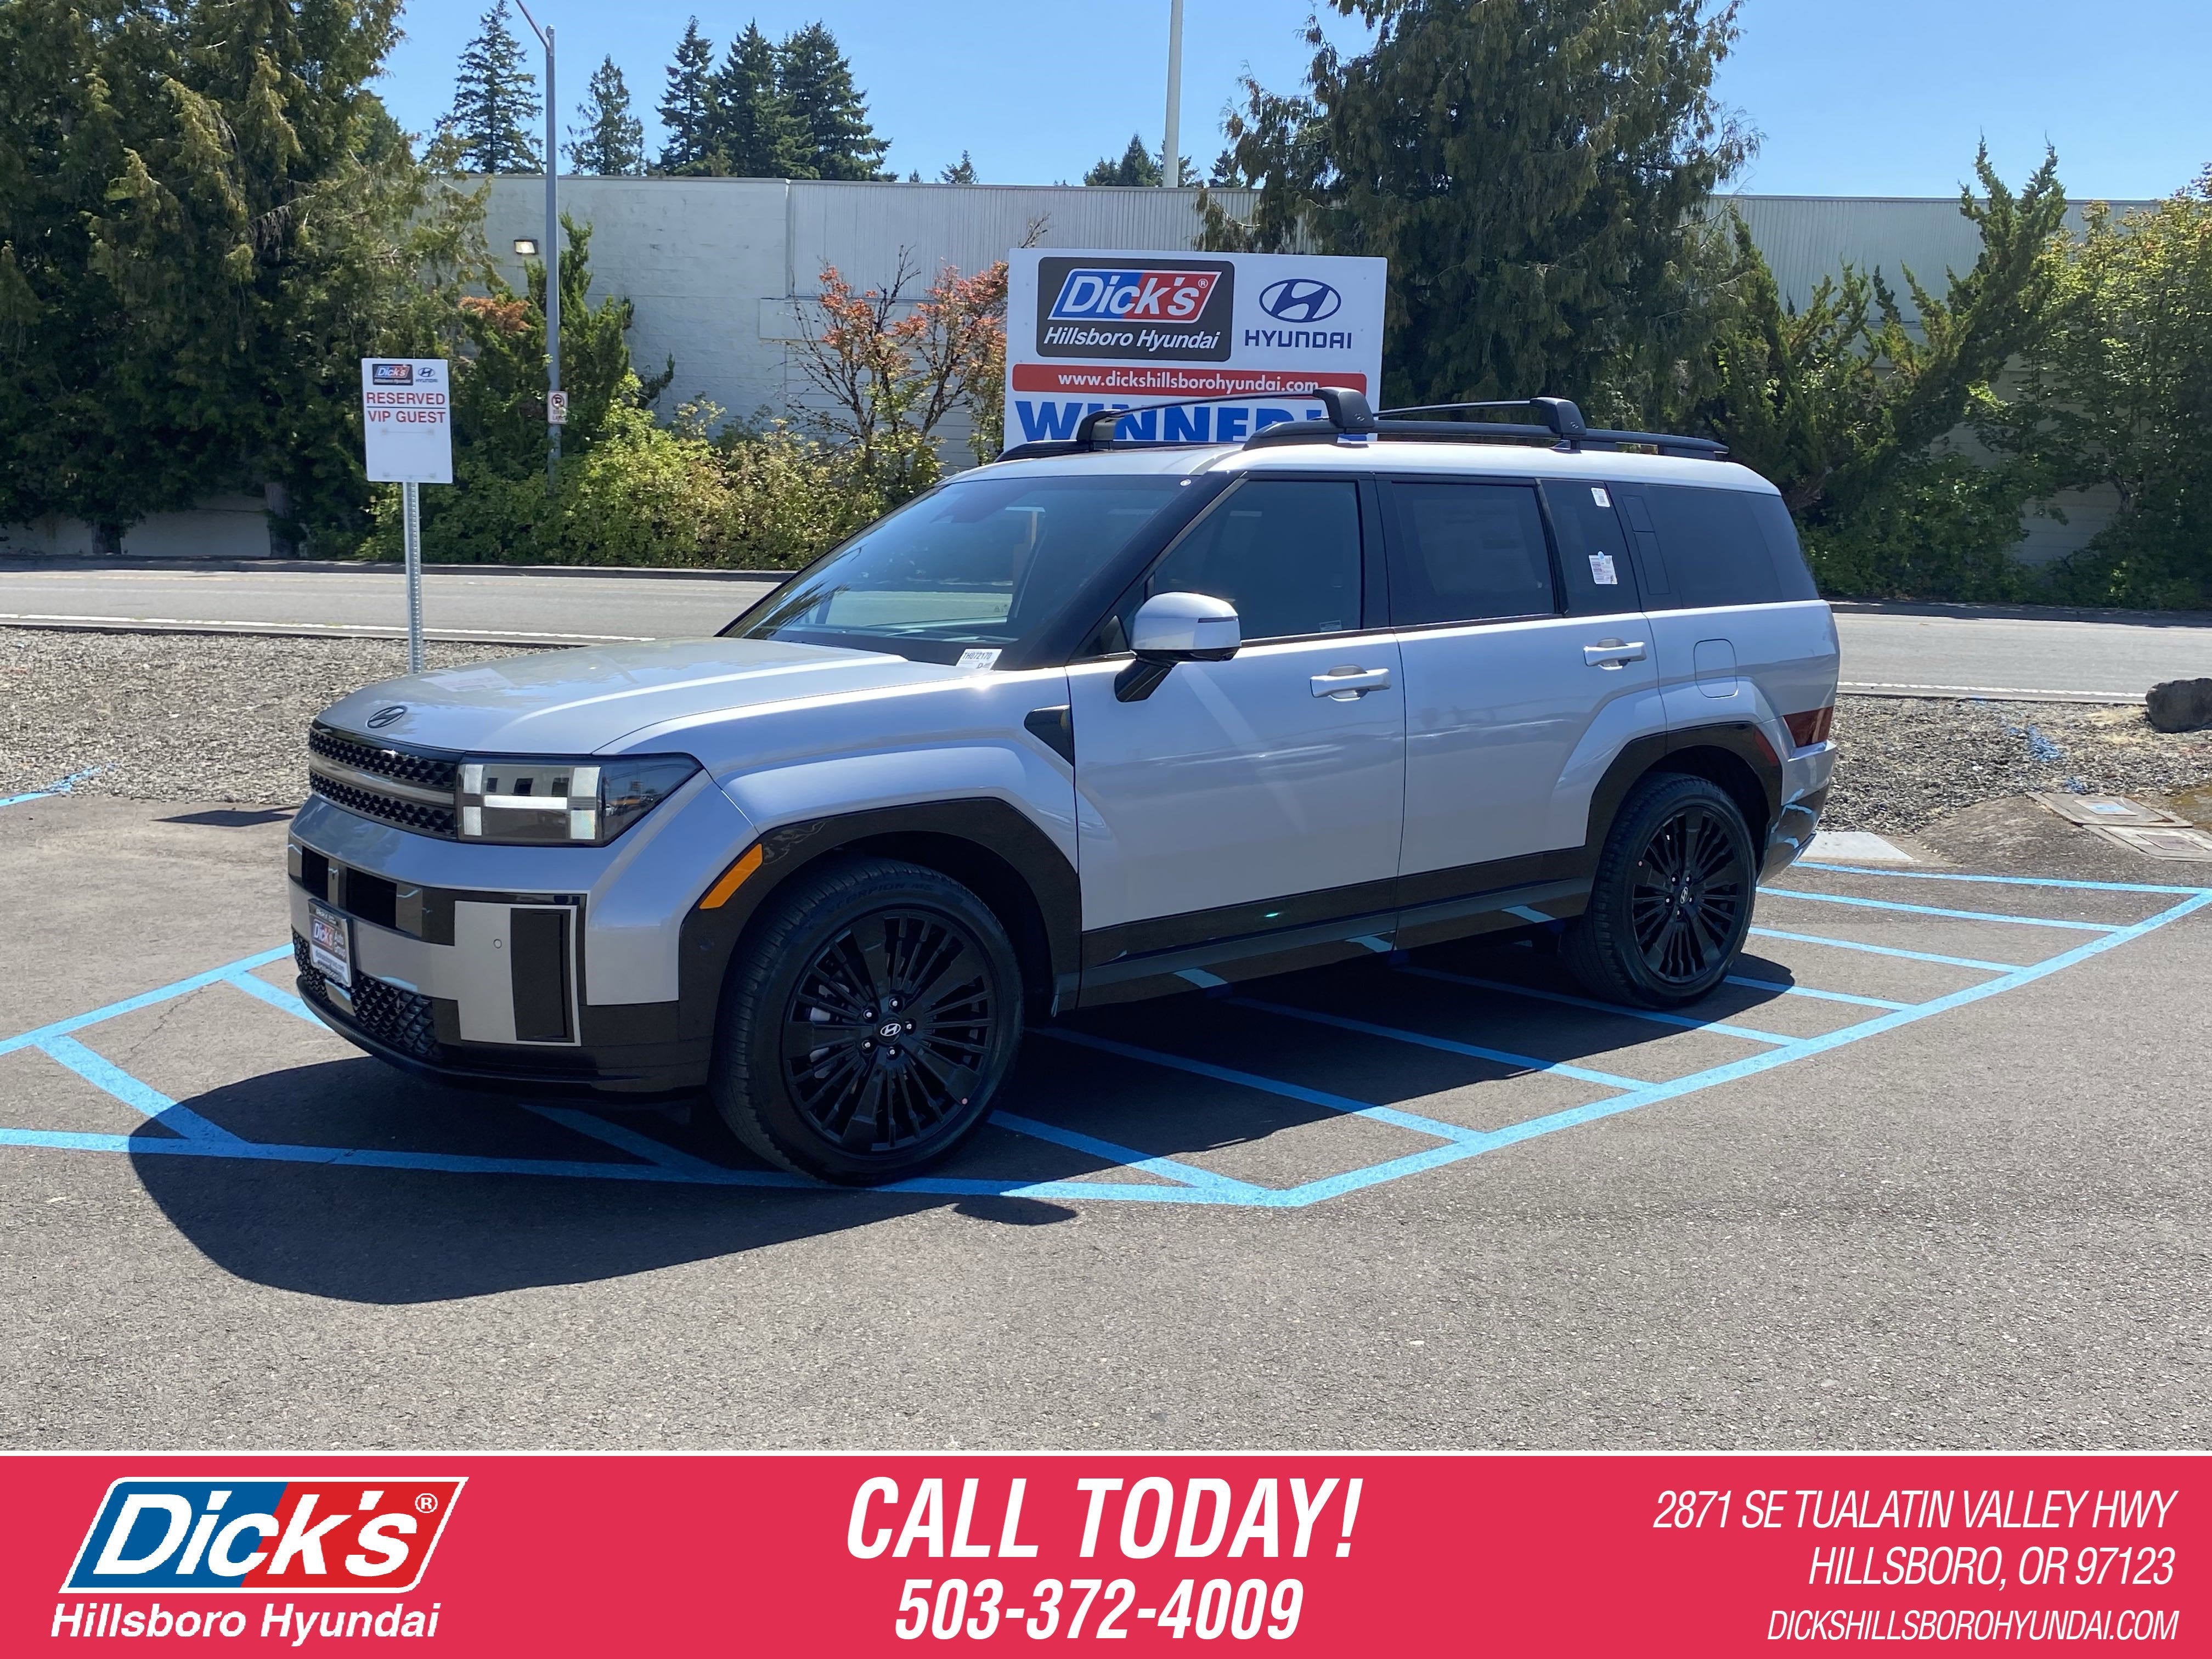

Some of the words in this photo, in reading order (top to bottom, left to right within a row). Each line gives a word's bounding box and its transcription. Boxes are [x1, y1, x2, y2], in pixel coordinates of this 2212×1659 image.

[1061, 275, 1200, 316] Dick's
[1043, 327, 1133, 346] Hillsboro
[1137, 330, 1221, 352] Hyundai
[1244, 330, 1352, 349] HYUNDAI
[377, 367, 407, 376] Dick's
[1058, 370, 1319, 395] www.dickshillsborohyundai.com
[366, 392, 445, 405] RESERVED
[368, 410, 391, 422] VIP
[396, 411, 446, 423] GUEST
[313, 922, 333, 947] Dick's
